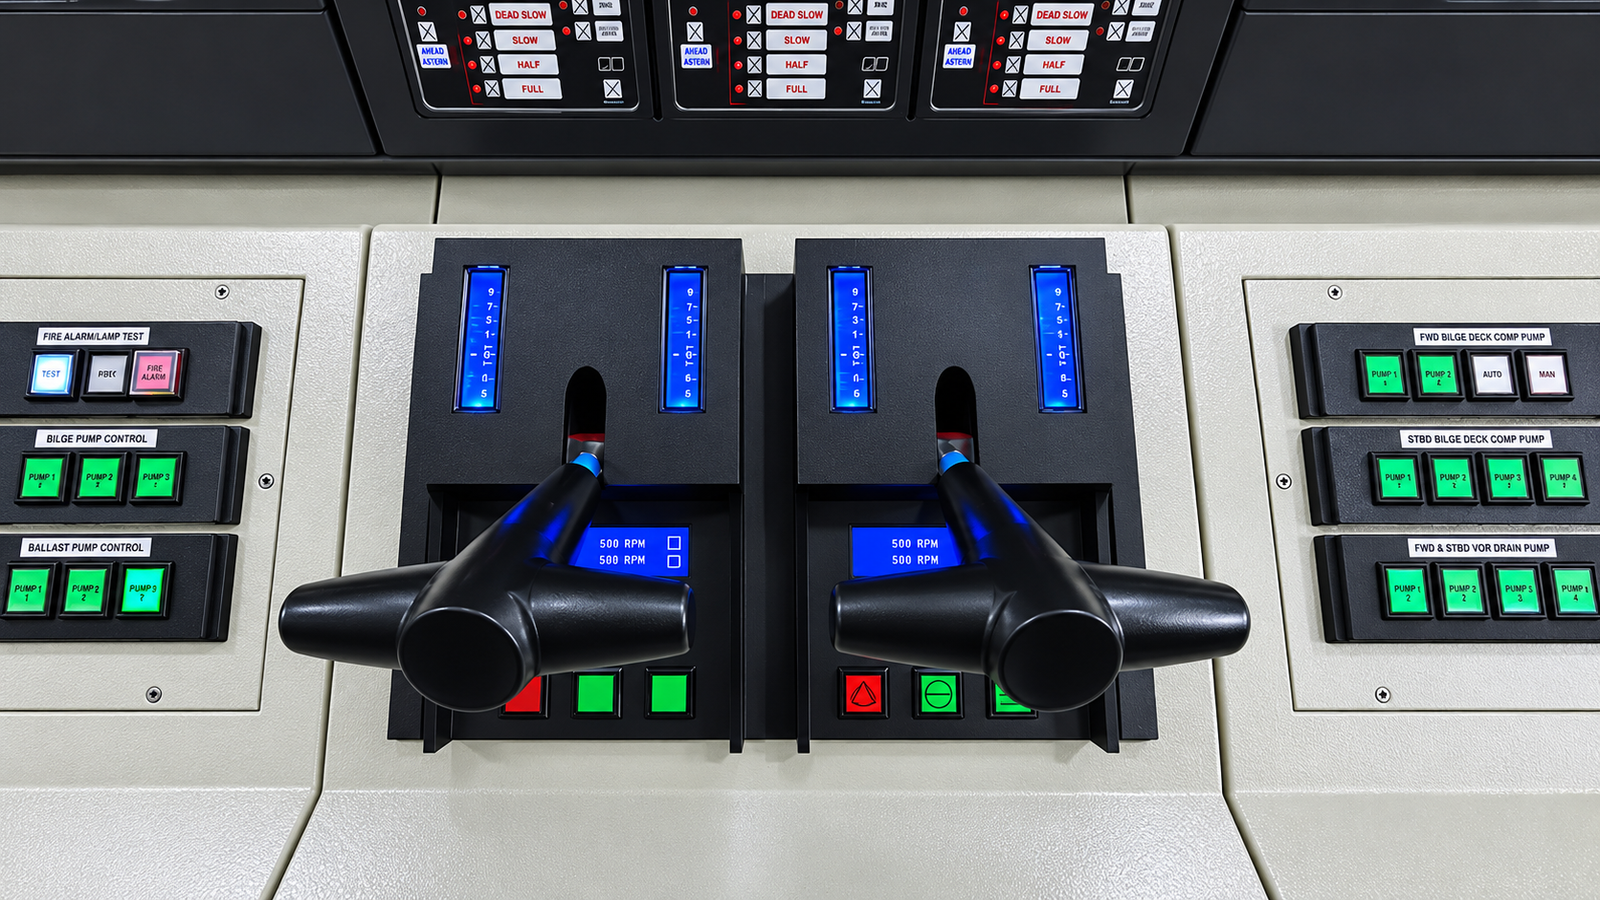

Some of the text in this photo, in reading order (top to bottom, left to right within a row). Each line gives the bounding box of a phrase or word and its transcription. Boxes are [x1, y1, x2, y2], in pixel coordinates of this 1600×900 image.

[495, 11, 547, 19] DEAD SLOW
[771, 10, 823, 19] DEAD SLOW
[1036, 11, 1088, 19] DEAD SLOW
[512, 36, 538, 45] SLOW
[784, 36, 810, 44] SLOW
[1045, 36, 1071, 44] SLOW
[947, 47, 972, 55] AHEAD
[517, 61, 540, 69] HALF
[945, 58, 972, 66] ASTERN
[522, 85, 544, 93] FULL
[786, 85, 808, 93] FULL
[1039, 85, 1061, 93] FULL
[43, 332, 144, 341] FIRE ALARM/LAMP TEST
[1420, 333, 1545, 341] FWD BILGE DECK COMP PUMP
[47, 435, 147, 443] BILGE PUMP CONTROL
[1408, 435, 1545, 443] STBD BILGE DECK COMP PUMP
[600, 539, 645, 548] 500 RPM
[892, 539, 938, 548] 500 RPM
[1414, 544, 1550, 552] FWD & STBD VOR DRAIN PUMP
[624, 555, 645, 565] RPM
[892, 556, 938, 565] 500 RPM
[14, 585, 37, 593] PUMP
[72, 585, 94, 593] PUMP
